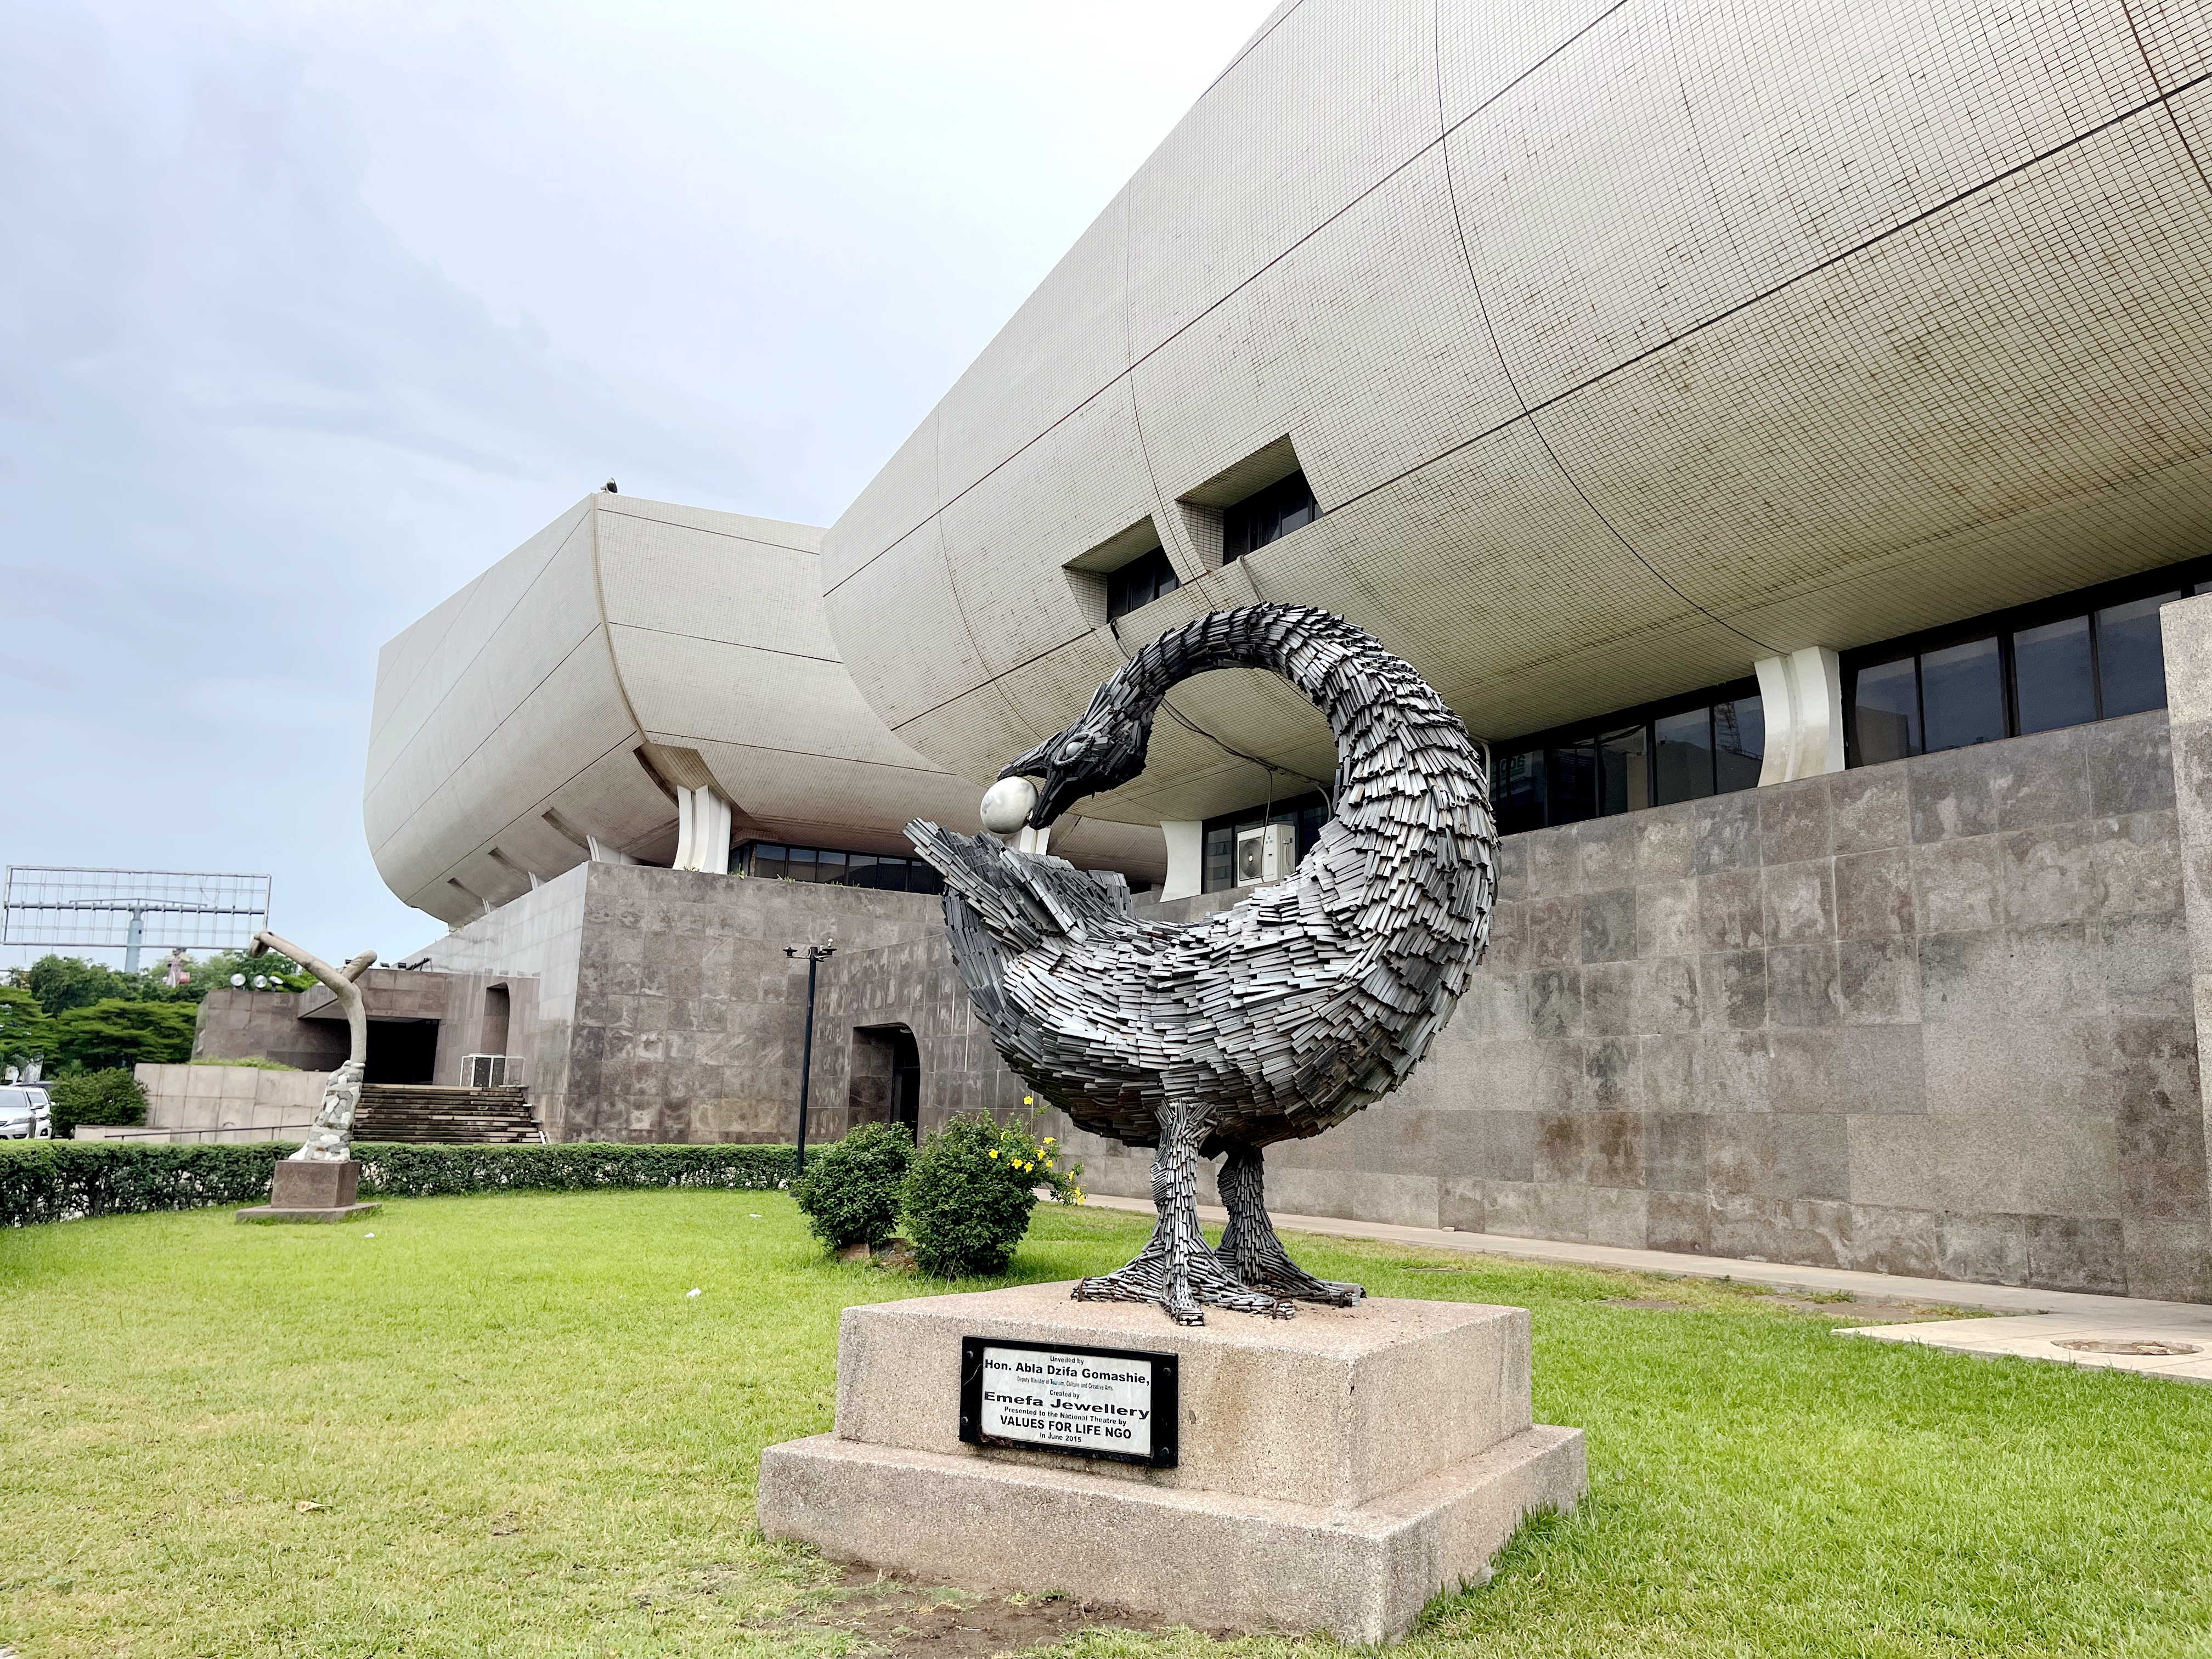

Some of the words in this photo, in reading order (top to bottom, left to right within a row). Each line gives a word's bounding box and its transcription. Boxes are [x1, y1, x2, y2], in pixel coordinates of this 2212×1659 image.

[985, 1359, 1012, 1370] Hon.
[1015, 1362, 1042, 1374] Abla
[1047, 1364, 1077, 1377] Dzifa
[1082, 1368, 1149, 1386] Gomashie,
[1017, 1375, 1030, 1384] Deputy
[1050, 1389, 1071, 1397] Created
[984, 1391, 1043, 1407] Emefa
[1050, 1398, 1149, 1420] Jewellery
[1005, 1406, 1037, 1415] Presented
[1060, 1412, 1088, 1421] National
[1090, 1415, 1116, 1424] Theatre
[1000, 1415, 1045, 1429] VALUES
[1048, 1420, 1071, 1432] FOR
[1076, 1424, 1101, 1435] LIFE
[1105, 1426, 1131, 1439] NGO
